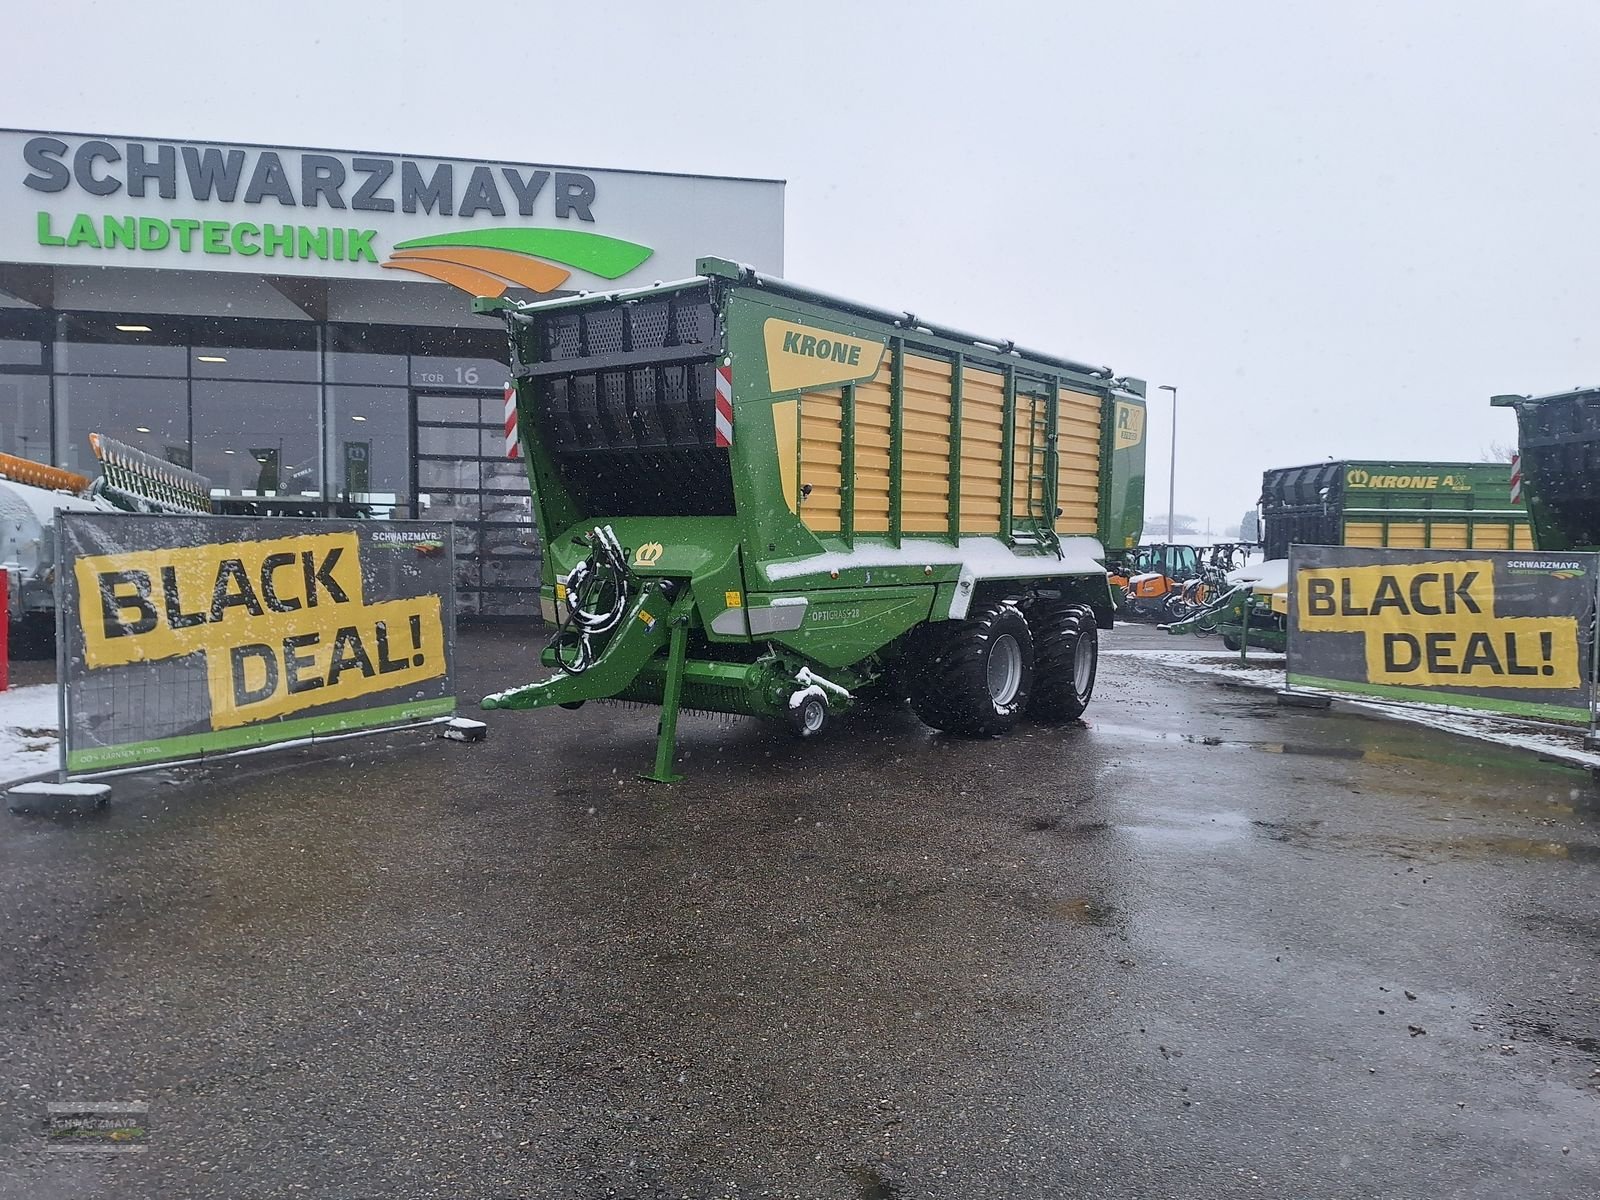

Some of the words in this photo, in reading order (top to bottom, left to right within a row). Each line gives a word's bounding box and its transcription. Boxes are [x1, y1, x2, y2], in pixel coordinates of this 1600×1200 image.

[23, 137, 597, 222] SCHWARZMAYR
[38, 212, 380, 263] LANDTECHNIK
[783, 331, 861, 366] KRONE
[421, 373, 444, 383] TOR
[455, 367, 479, 385] 16
[1368, 475, 1439, 489] KRONE
[372, 532, 437, 541] SCHWARZMAYR
[1507, 561, 1580, 569] SCHWARZMAYR
[97, 547, 349, 639] BLACK
[1308, 571, 1481, 616] BLACK
[230, 614, 425, 707] DEAL!
[1383, 631, 1555, 676] DEAL!
